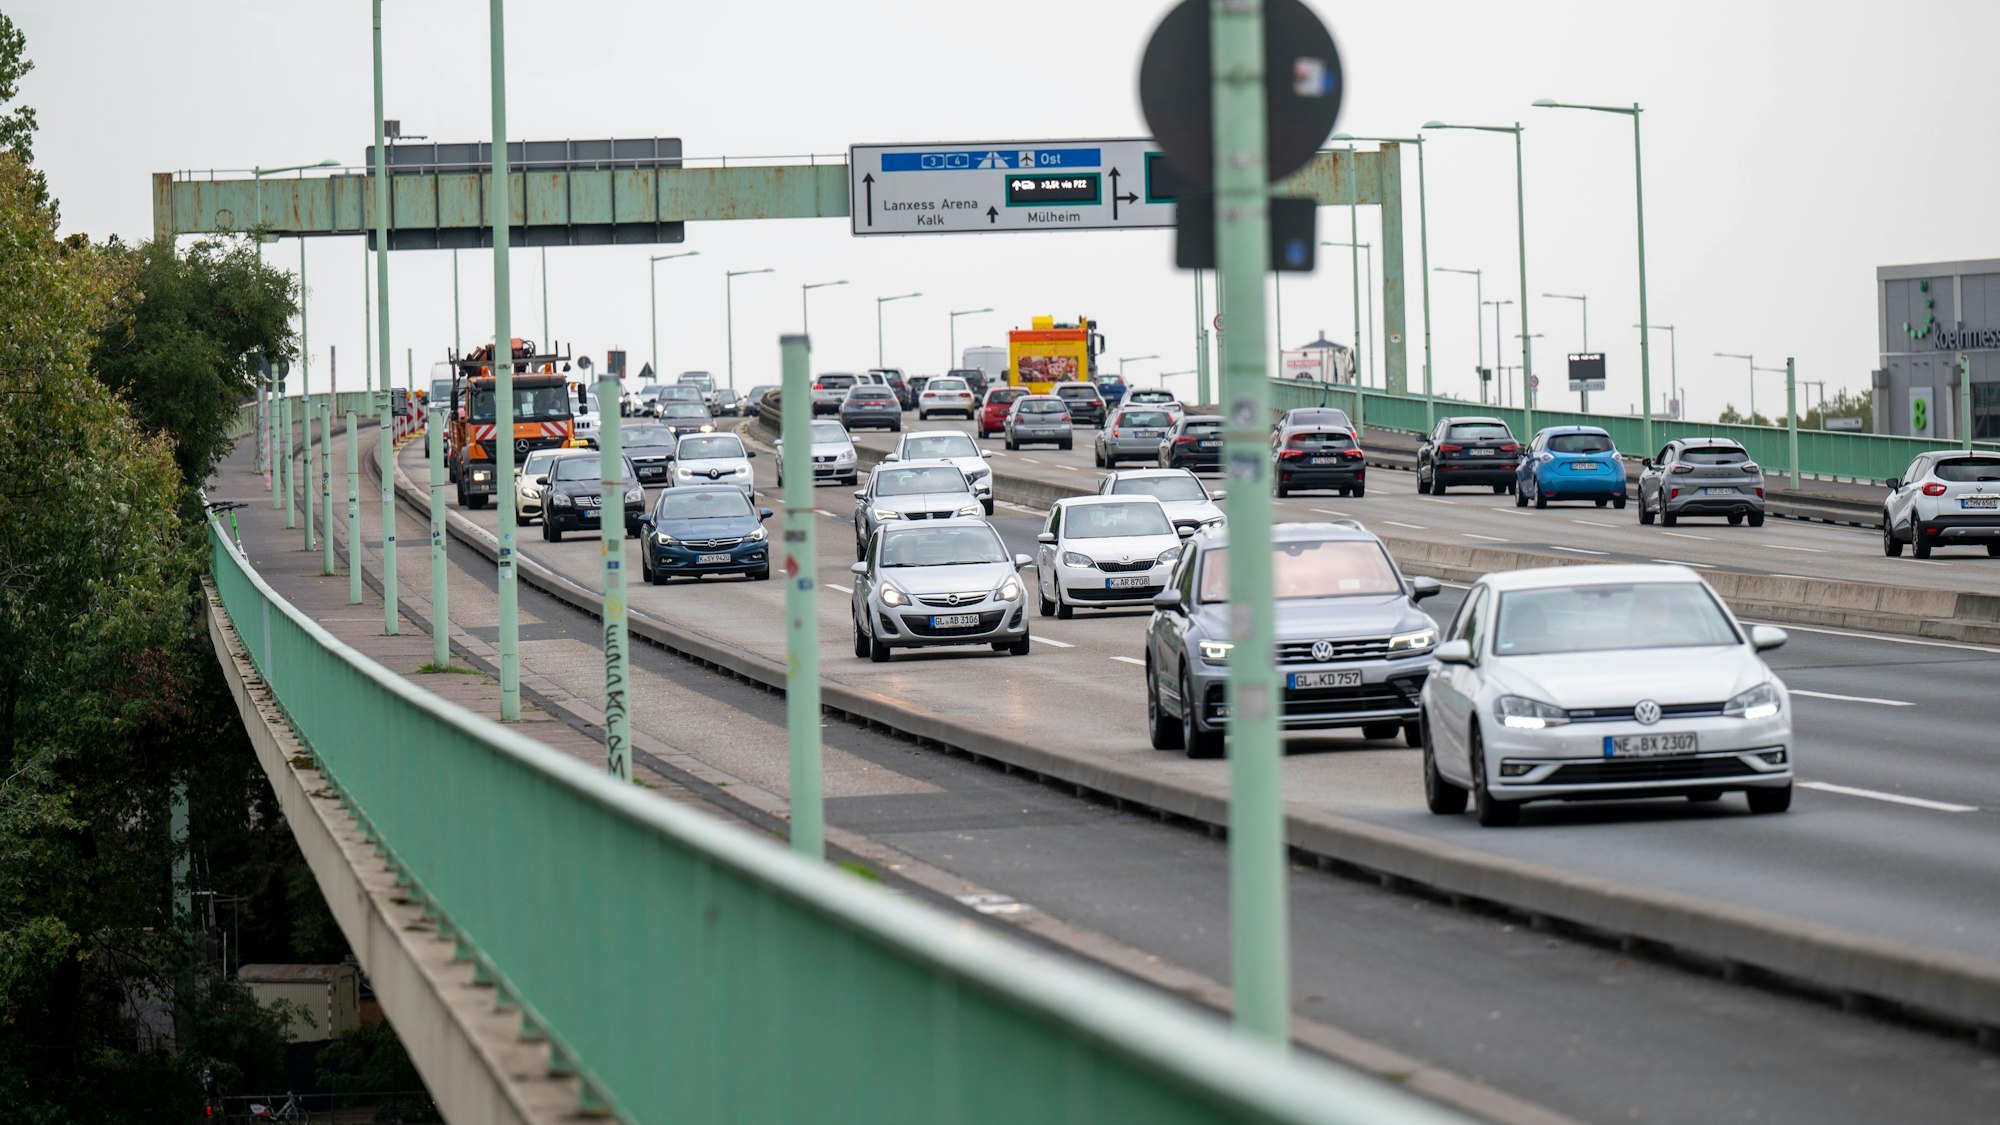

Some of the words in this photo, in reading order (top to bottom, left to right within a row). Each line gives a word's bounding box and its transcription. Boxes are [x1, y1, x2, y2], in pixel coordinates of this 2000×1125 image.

[930, 157, 937, 166] 3
[954, 156, 961, 165] 4
[1040, 153, 1062, 165] Ost
[883, 200, 935, 211] Lanxess
[941, 198, 978, 210] Arena
[917, 214, 945, 226] Kalk
[1028, 211, 1081, 223] Mülheim
[1912, 398, 1927, 431] 8
[1130, 578, 1148, 586] 8708
[935, 617, 945, 625] GL
[950, 616, 959, 624] AB
[960, 615, 979, 624] 3106
[1311, 641, 1334, 662] VW
[1296, 675, 1312, 687] GL
[1319, 674, 1335, 686] KD
[1337, 672, 1359, 684] 757
[1634, 699, 1661, 726] VW
[1613, 738, 1631, 752] NE
[1640, 737, 1658, 751] BX
[1661, 735, 1694, 750] 2307
